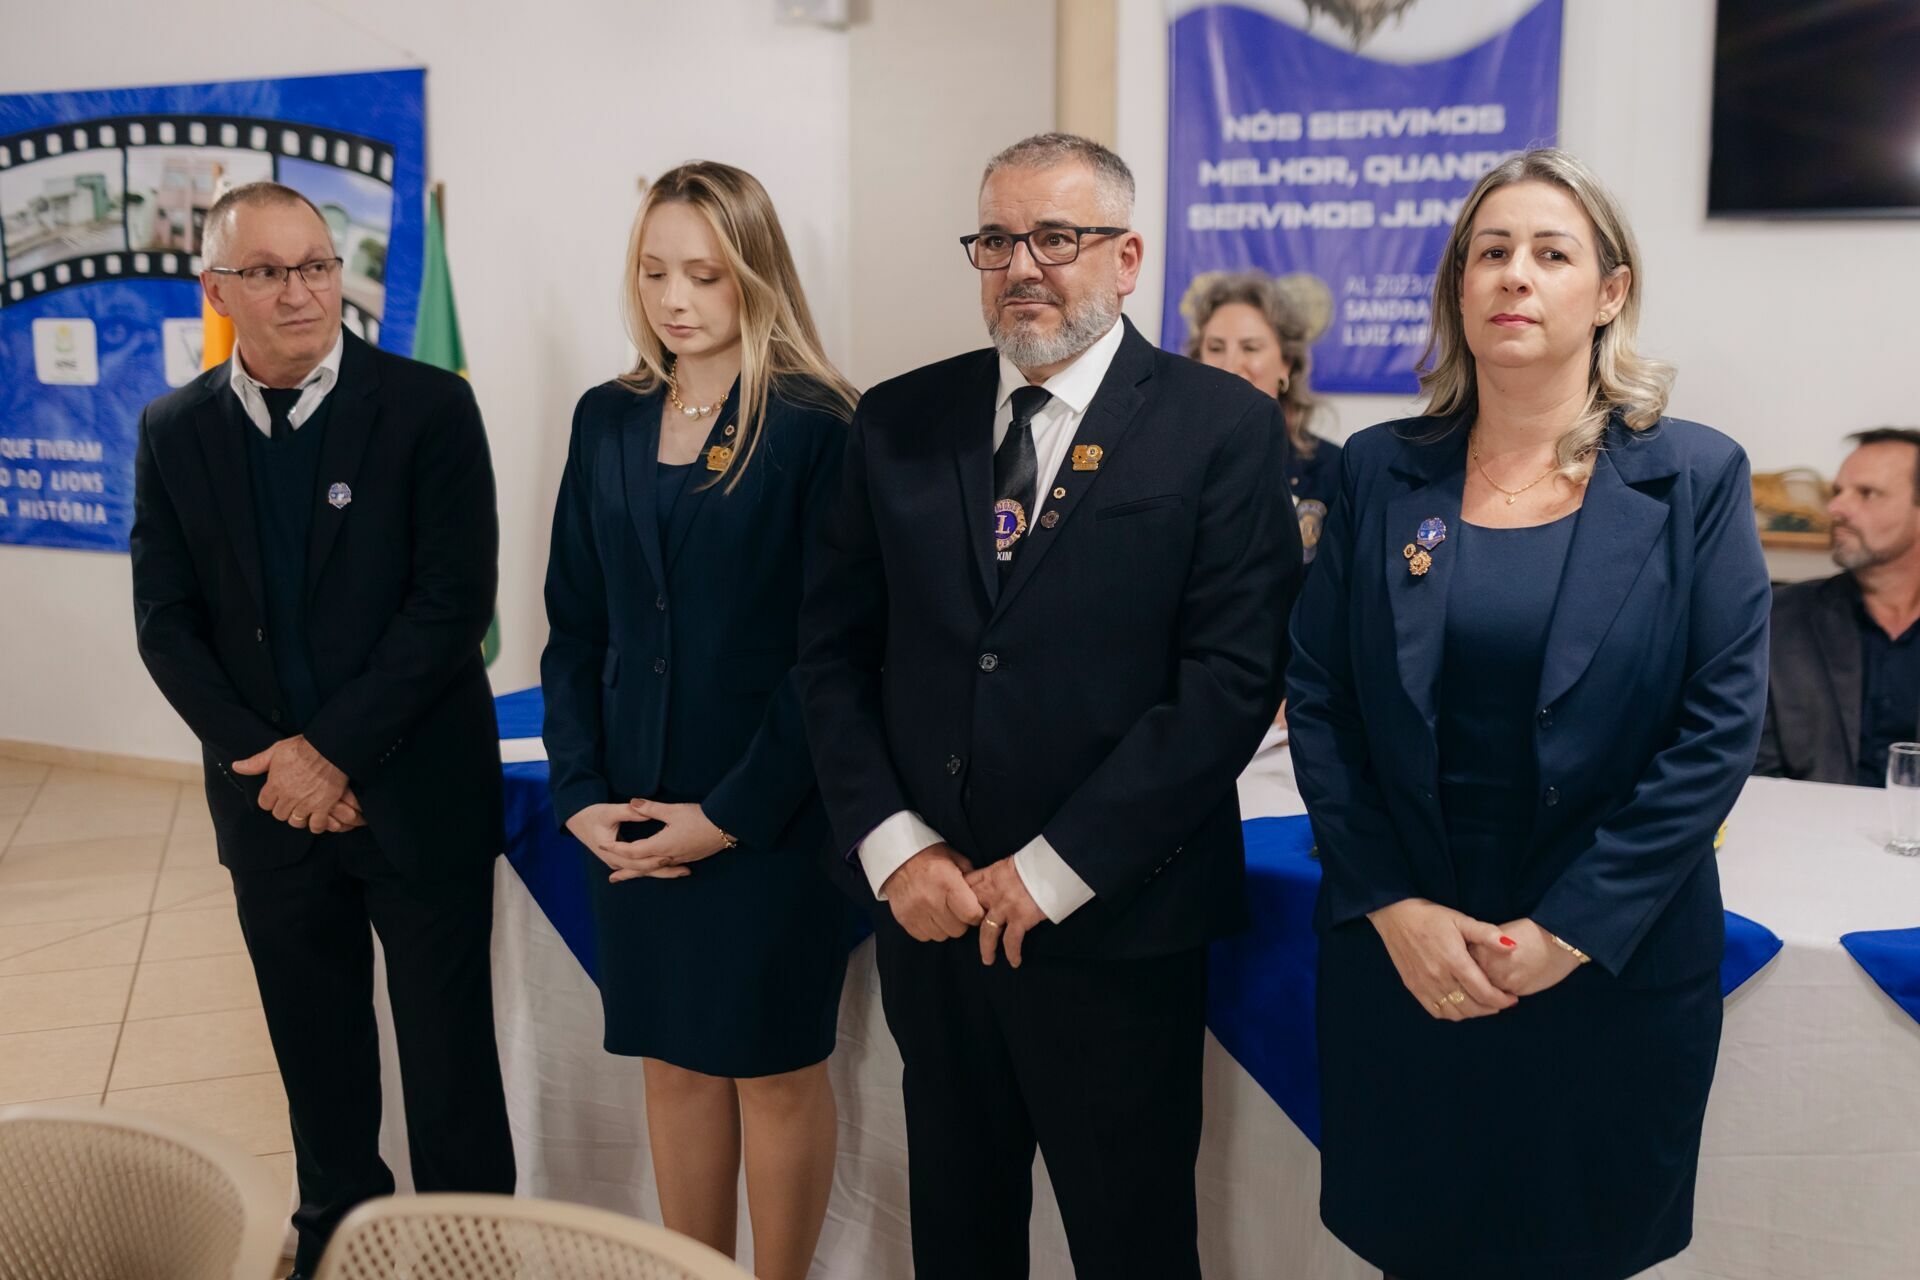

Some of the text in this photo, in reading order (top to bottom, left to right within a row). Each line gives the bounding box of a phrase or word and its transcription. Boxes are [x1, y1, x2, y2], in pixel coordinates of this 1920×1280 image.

[1223, 105, 1505, 142] NÓS SERVIMOS
[1198, 151, 1522, 187] MELHOR, QUAND
[1187, 201, 1375, 231] SERVIMOS
[50, 470, 105, 493] LIONS
[18, 497, 108, 524] HISTÓRIA
